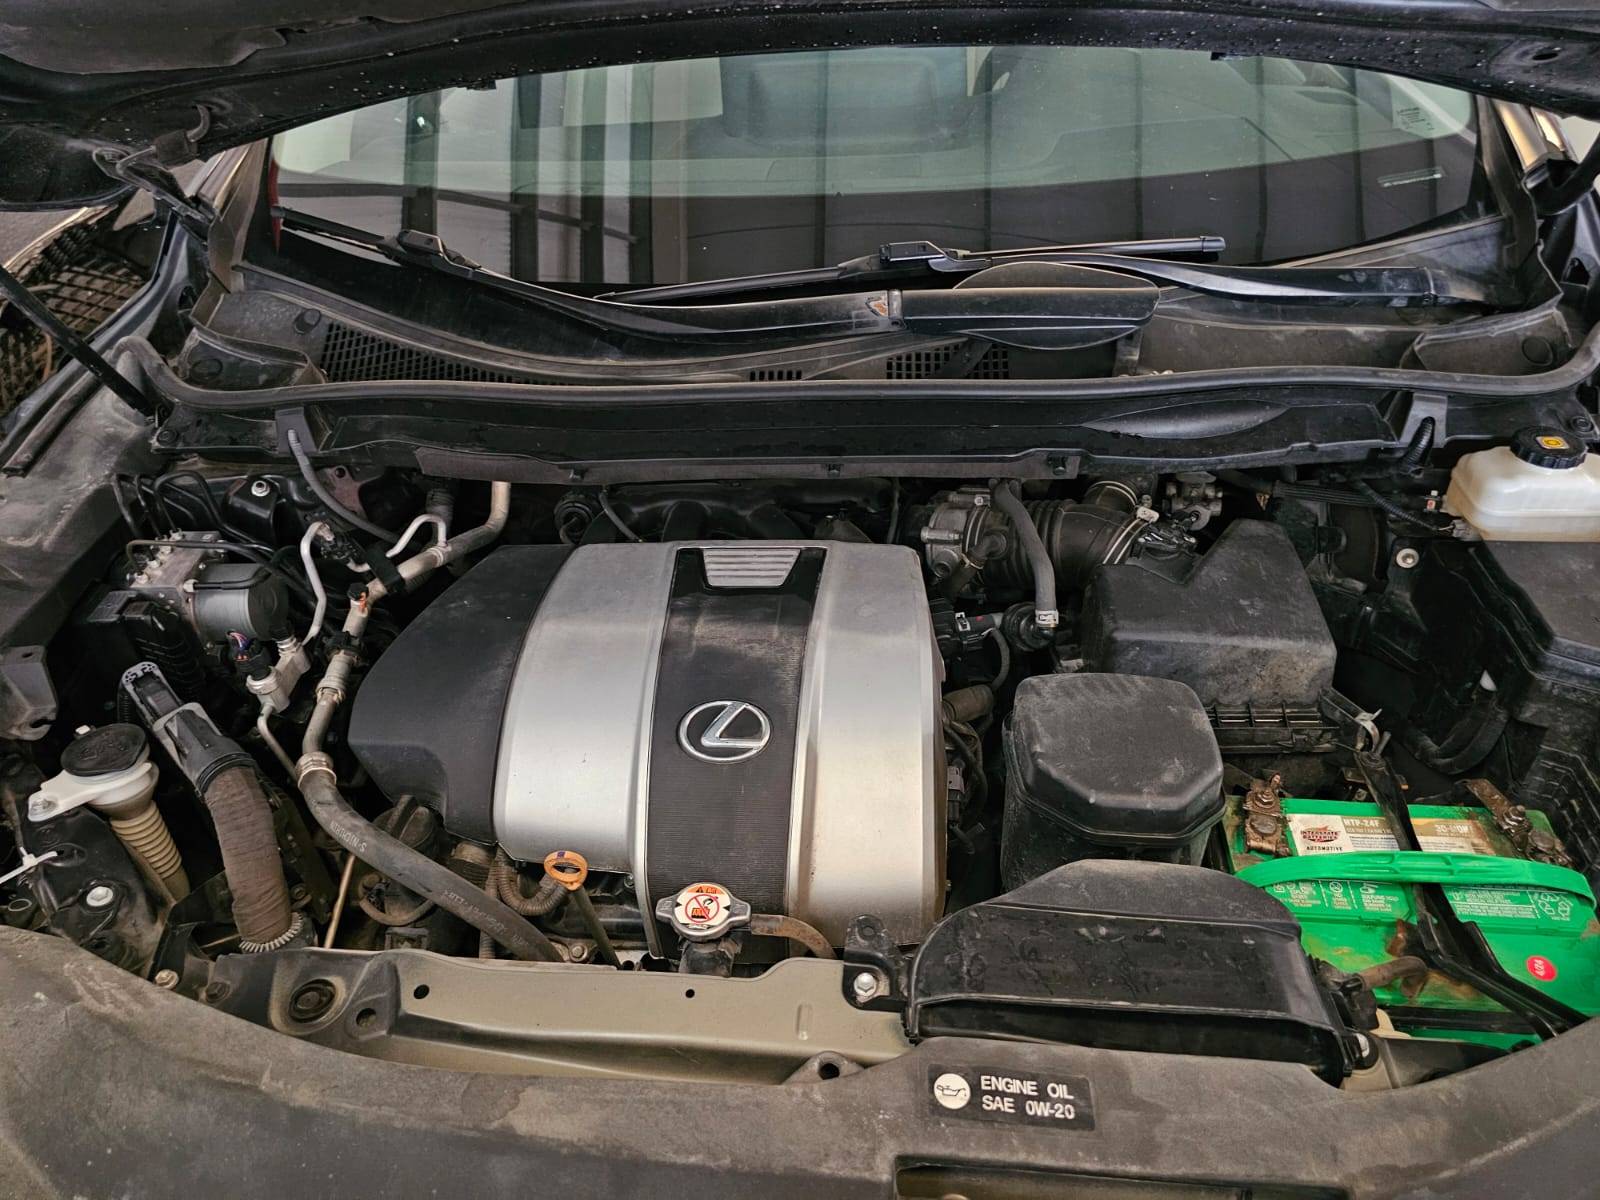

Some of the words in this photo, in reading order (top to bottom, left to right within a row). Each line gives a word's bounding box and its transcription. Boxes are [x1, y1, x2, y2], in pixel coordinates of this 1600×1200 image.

[980, 1075, 1039, 1096] ENGINE
[1047, 1083, 1075, 1100] OIL
[982, 1095, 1016, 1113] SAE
[1025, 1101, 1075, 1120] 0W-20
